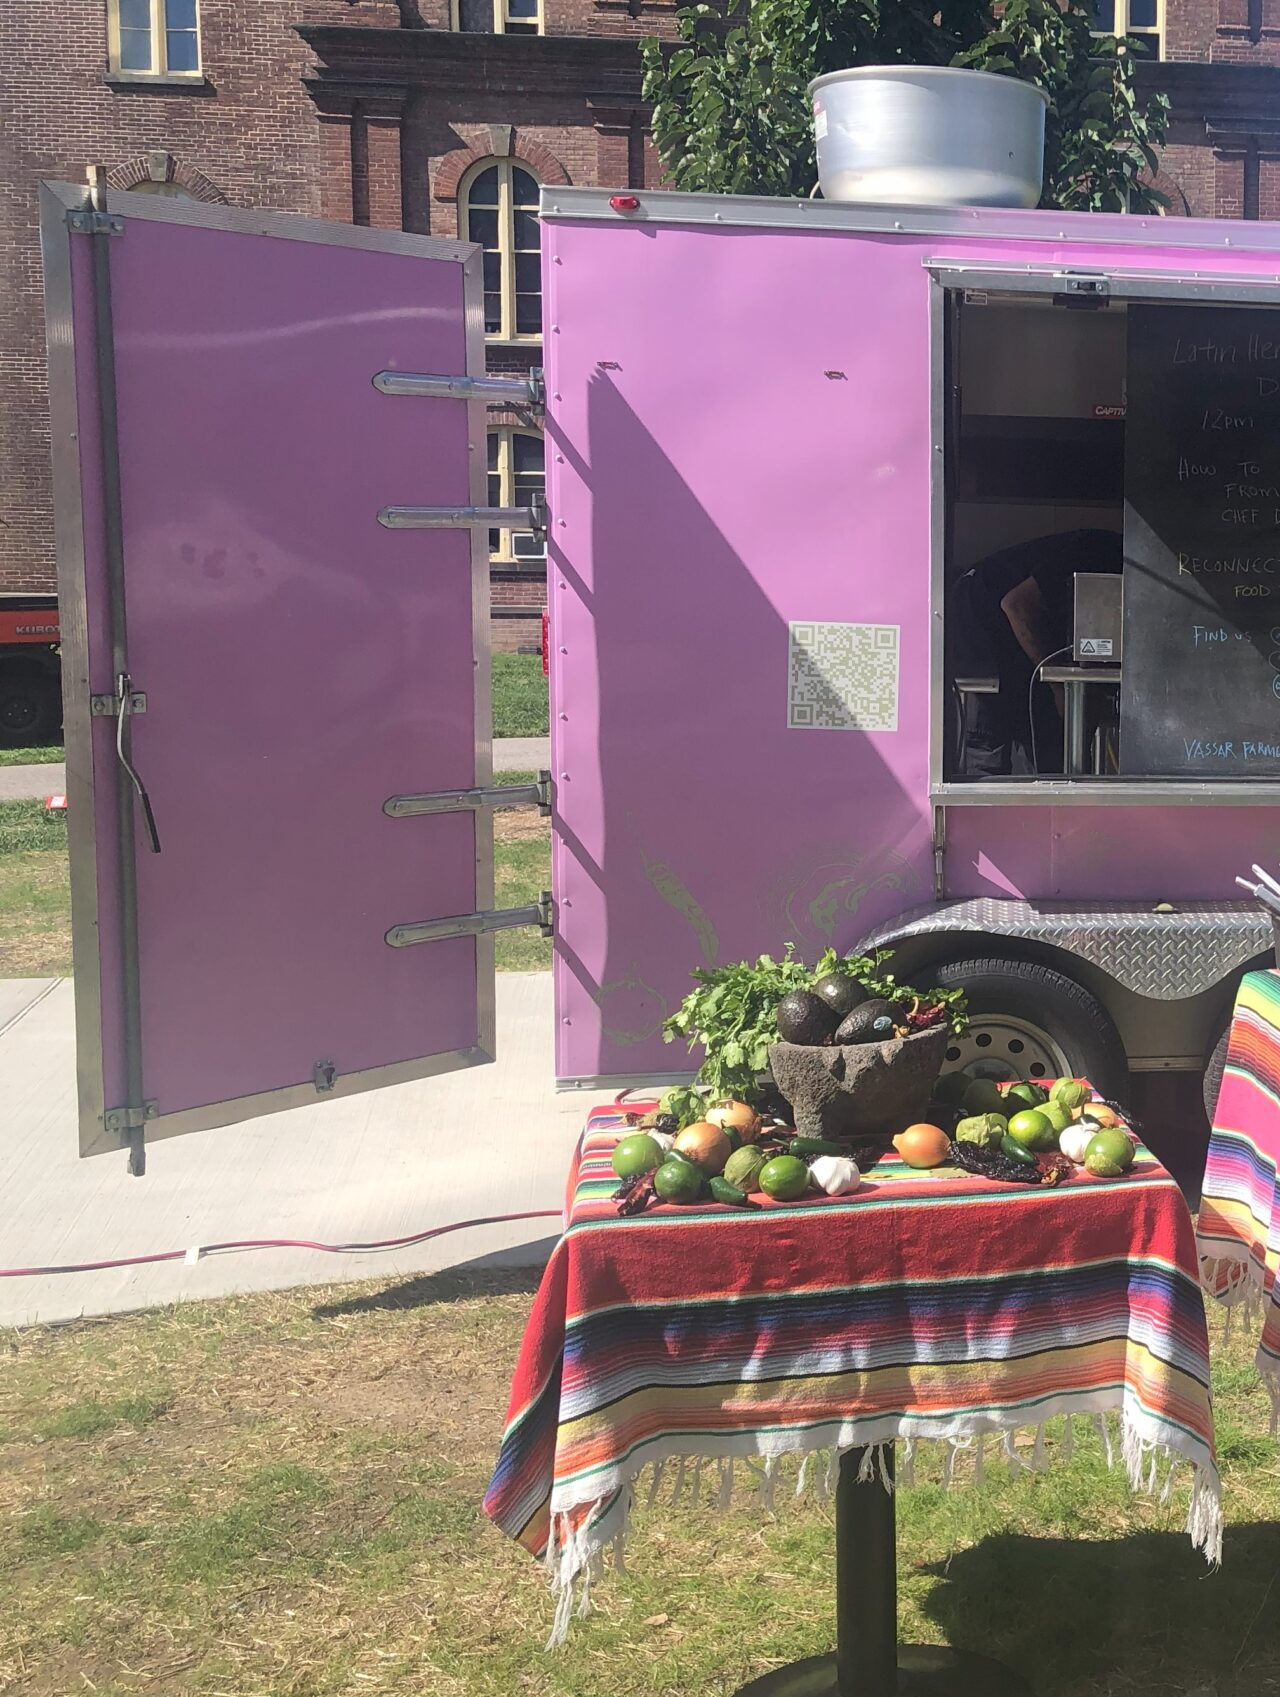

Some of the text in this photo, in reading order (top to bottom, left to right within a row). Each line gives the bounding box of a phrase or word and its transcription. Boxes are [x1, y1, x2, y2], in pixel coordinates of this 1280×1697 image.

[1172, 335, 1236, 364] Latin
[1224, 482, 1280, 499] FROM
[1221, 507, 1259, 523] CHEF
[1235, 584, 1271, 598] FOOD
[1192, 625, 1228, 647] FIND
[1184, 738, 1237, 761] VASSAR
